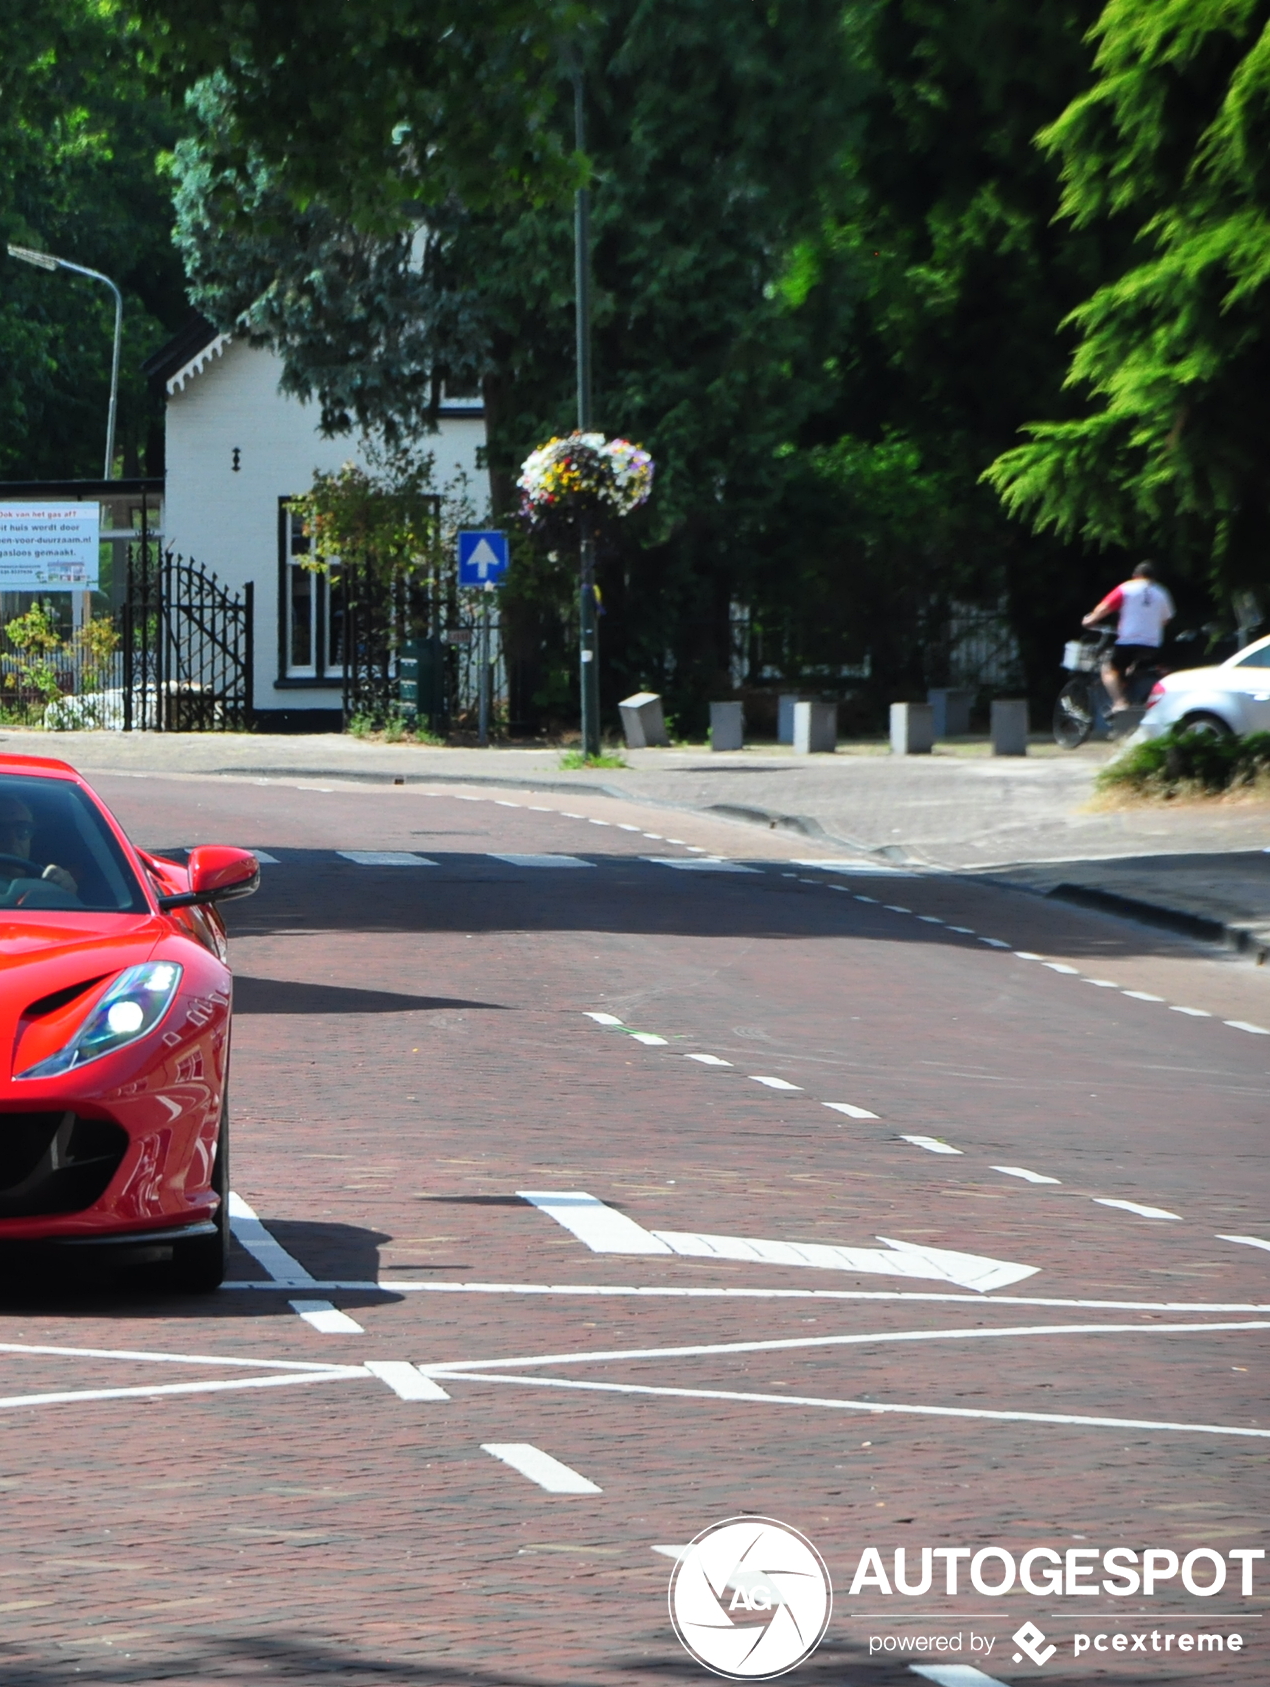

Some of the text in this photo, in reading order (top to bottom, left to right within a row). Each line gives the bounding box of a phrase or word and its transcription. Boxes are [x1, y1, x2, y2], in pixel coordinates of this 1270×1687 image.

[10, 524, 29, 532] huis
[31, 524, 57, 532] wordt
[60, 524, 80, 532] door
[34, 549, 76, 558] gemaakt.
